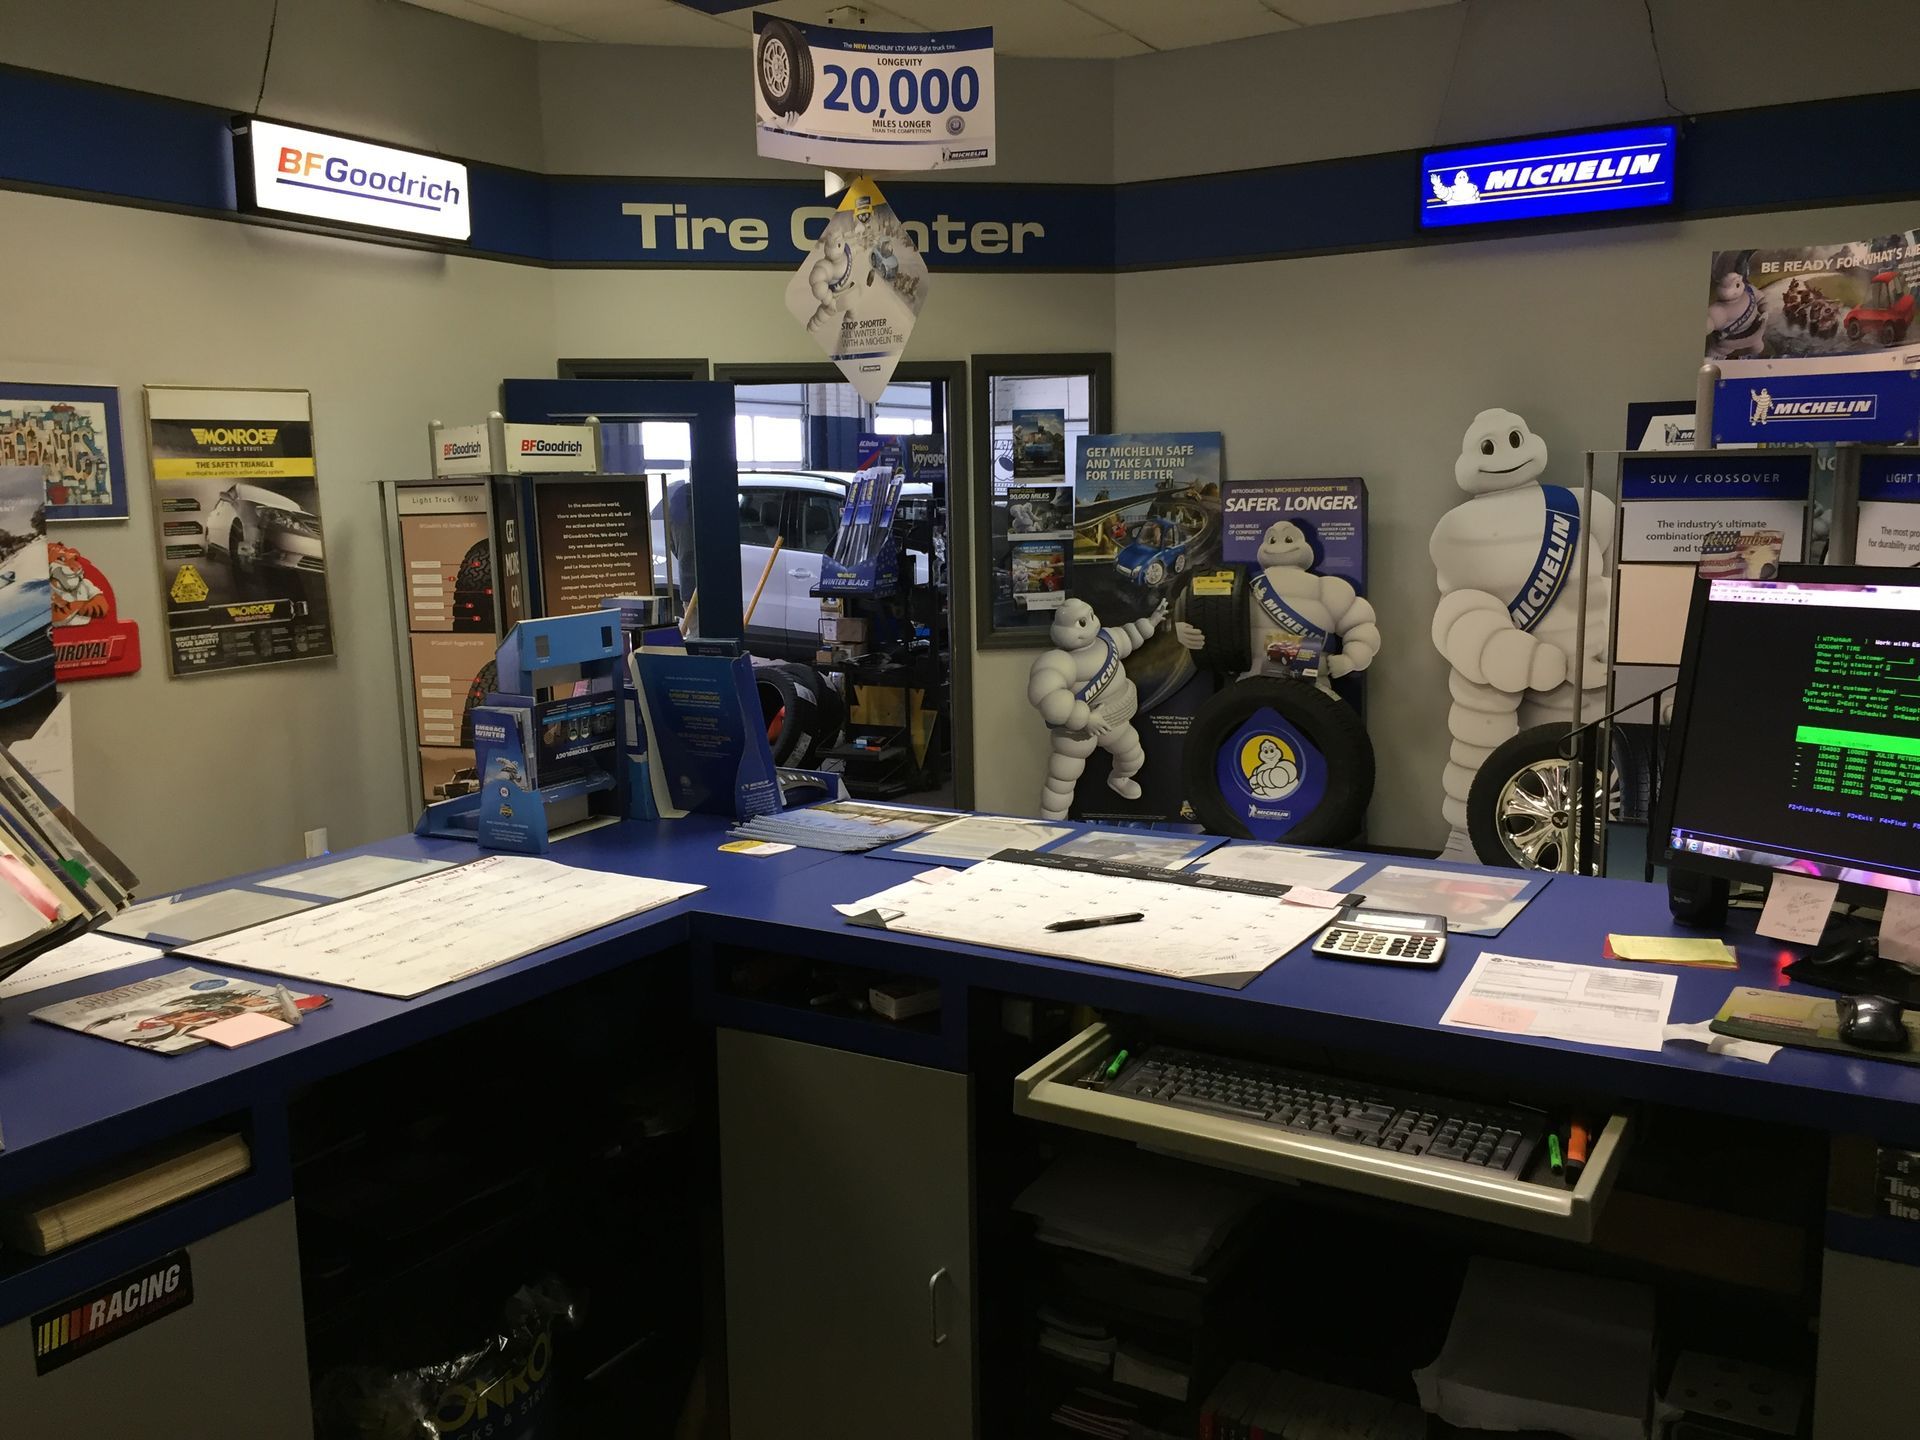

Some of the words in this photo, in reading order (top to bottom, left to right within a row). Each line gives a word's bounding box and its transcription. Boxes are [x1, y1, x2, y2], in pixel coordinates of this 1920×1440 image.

[877, 57, 922, 67] LONGEVITY
[823, 64, 979, 118] 20,000
[872, 119, 897, 128] MILES
[898, 119, 931, 128] LONGER
[951, 149, 987, 159] MICHELIN
[278, 146, 460, 204] BFGoodrich
[1484, 153, 1661, 191] MICHELIN
[621, 203, 769, 251] Tire
[790, 203, 1045, 254] Cnter
[1761, 261, 1780, 274] BE
[1783, 258, 1833, 273] READY
[1836, 255, 1860, 269] FOR
[1862, 247, 1902, 267] WHAT'S
[841, 321, 858, 330] STOP
[859, 318, 887, 329] SHORTER
[842, 329, 852, 338] ALL
[854, 328, 877, 338] WINTER
[877, 326, 893, 336] LONG
[842, 338, 859, 347] WITH
[859, 338, 865, 347] A
[866, 335, 892, 346] MICHELIN
[893, 334, 903, 343] TIRE
[1774, 400, 1872, 415] MICHELIN
[197, 428, 275, 446] MONROE
[444, 441, 481, 456] BFGoodrich
[521, 439, 582, 453] BFGoodrich
[912, 444, 929, 452] Delco
[1086, 447, 1108, 457] GET
[1110, 446, 1164, 457] MICHELIN
[1166, 445, 1194, 456] SAFE
[196, 461, 210, 469] THE
[210, 461, 239, 469] SAFETY
[240, 460, 274, 468] TRIANGLE
[1086, 458, 1112, 469] AND
[1114, 458, 1142, 468] TAKE
[1143, 457, 1152, 468] A
[1155, 457, 1185, 468] TURN
[1085, 470, 1104, 480] FOR
[1106, 470, 1131, 480] THE
[1133, 469, 1174, 480] BETTER
[1650, 474, 1676, 484] SUV
[1682, 473, 1689, 484] /
[1695, 473, 1780, 483] CROSSOVER
[1886, 473, 1913, 483] LIGHT
[412, 497, 432, 505] Light
[1030, 492, 1050, 500] MILES
[1224, 497, 1281, 512] SAFER.
[1284, 495, 1358, 511] LONGER.
[1656, 520, 1675, 529] The
[1677, 519, 1724, 532] industry's
[1725, 519, 1767, 529] ultimate
[1881, 526, 1892, 535] The
[1893, 528, 1908, 537] most
[1702, 532, 1776, 546] Remember
[1868, 537, 1877, 547] for
[1877, 539, 1907, 552] durability
[1672, 543, 1691, 554] and
[822, 578, 846, 586] WINTER
[847, 578, 871, 587] BLADE
[228, 602, 275, 616] MONROE
[175, 640, 194, 649] YOUR
[194, 637, 219, 647] SAFETY?
[475, 729, 506, 739] WINTER
[555, 746, 589, 760] TECHNOLOGY
[1870, 783, 1886, 791] FORD
[1256, 809, 1289, 817] MICHELIN
[1815, 807, 1841, 817] Product
[1883, 1176, 1920, 1199] Tire
[1883, 1197, 1920, 1220] Tire
[88, 1263, 181, 1331] RACING
